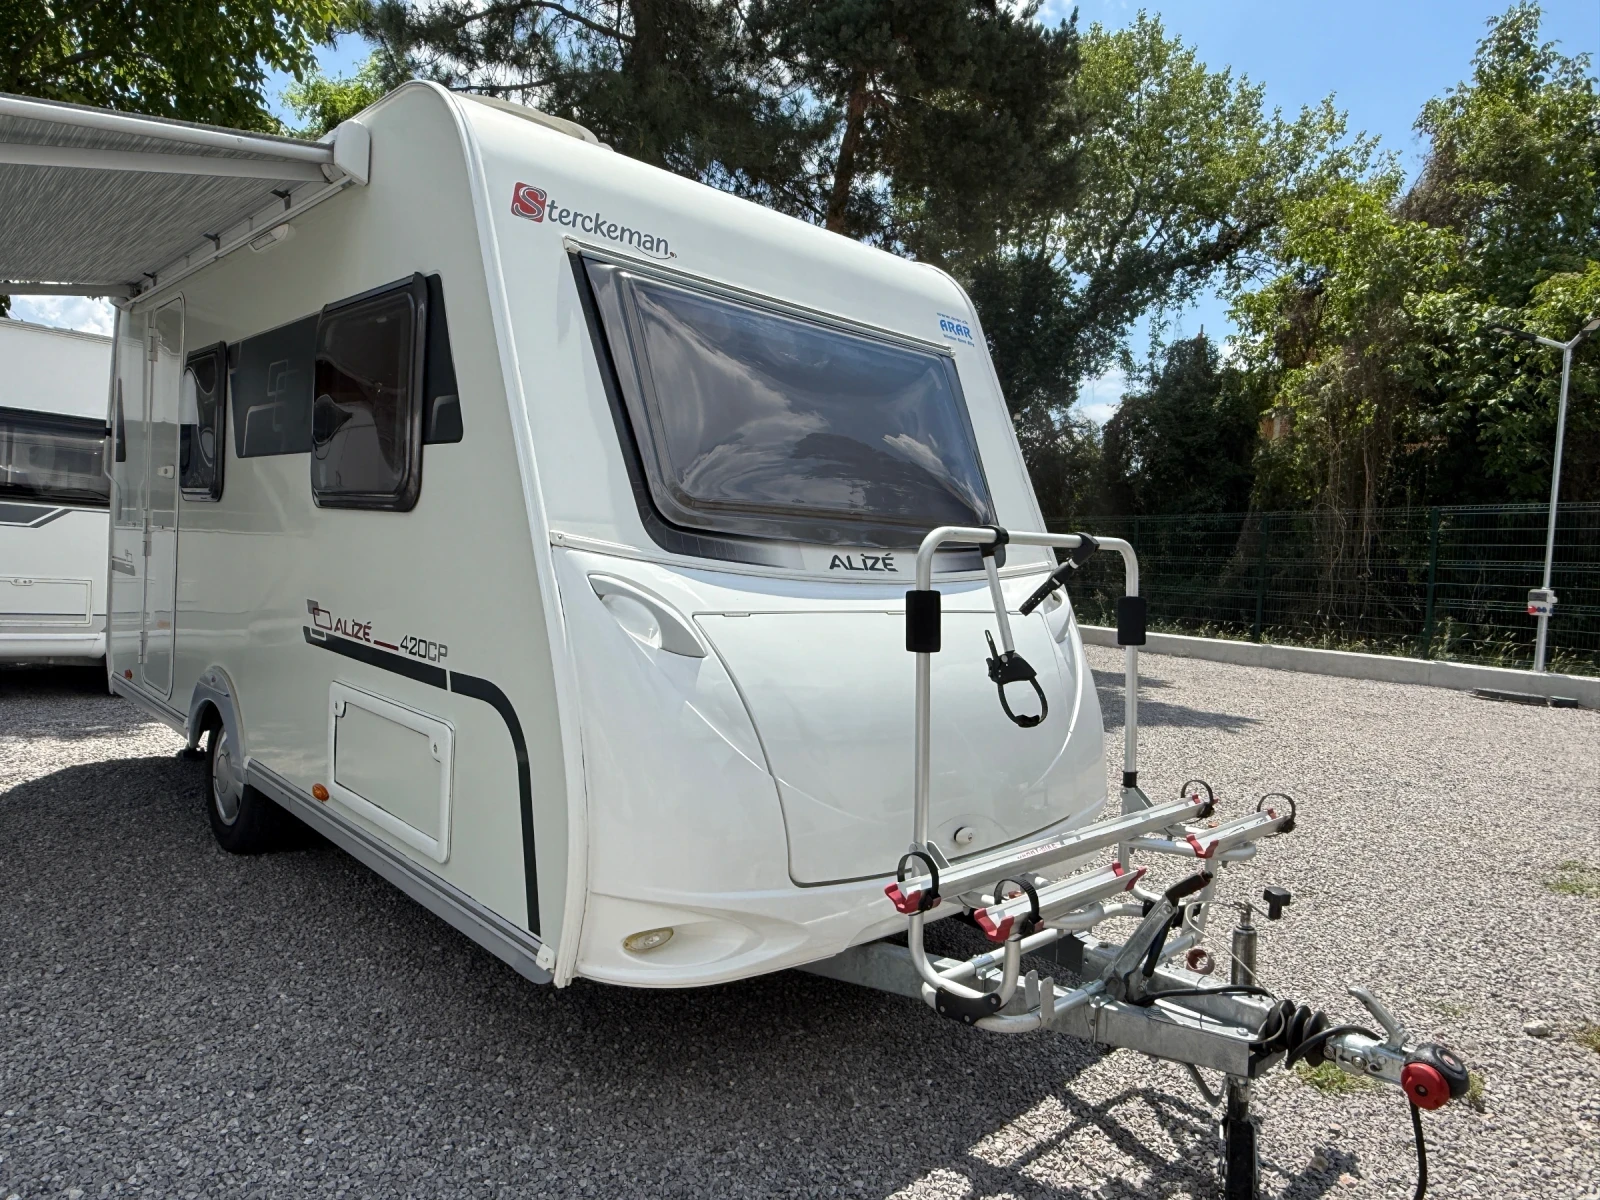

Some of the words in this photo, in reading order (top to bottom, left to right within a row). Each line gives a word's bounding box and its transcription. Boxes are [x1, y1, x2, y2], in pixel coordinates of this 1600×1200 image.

[511, 183, 669, 256] Sterckeman
[940, 319, 973, 340] ARAR
[400, 634, 448, 663] 420CP
